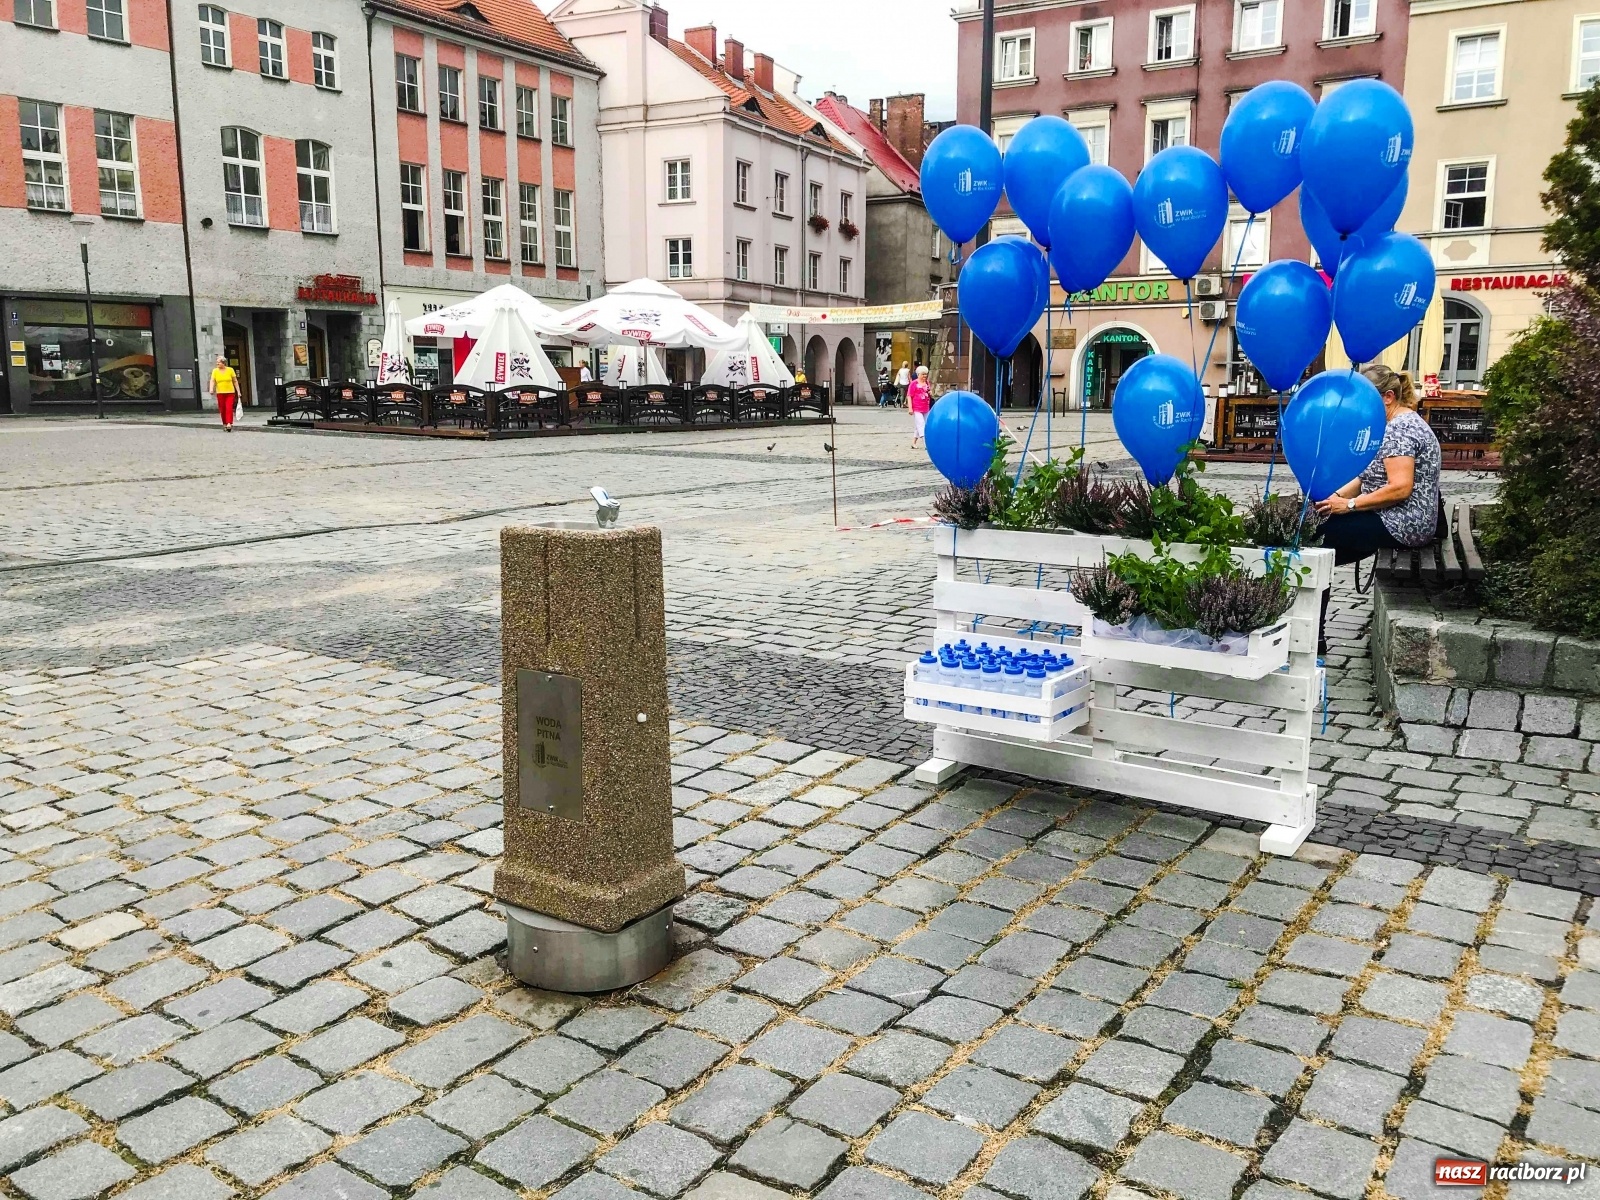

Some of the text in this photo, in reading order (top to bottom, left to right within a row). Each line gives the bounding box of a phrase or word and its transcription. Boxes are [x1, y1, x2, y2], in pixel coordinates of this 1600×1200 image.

[1103, 334, 1140, 343] KANTOR
[1085, 351, 1095, 397] KANTOR
[1456, 422, 1479, 432] TYSKIE
[535, 715, 562, 730] WODA
[536, 728, 562, 741] PITNA
